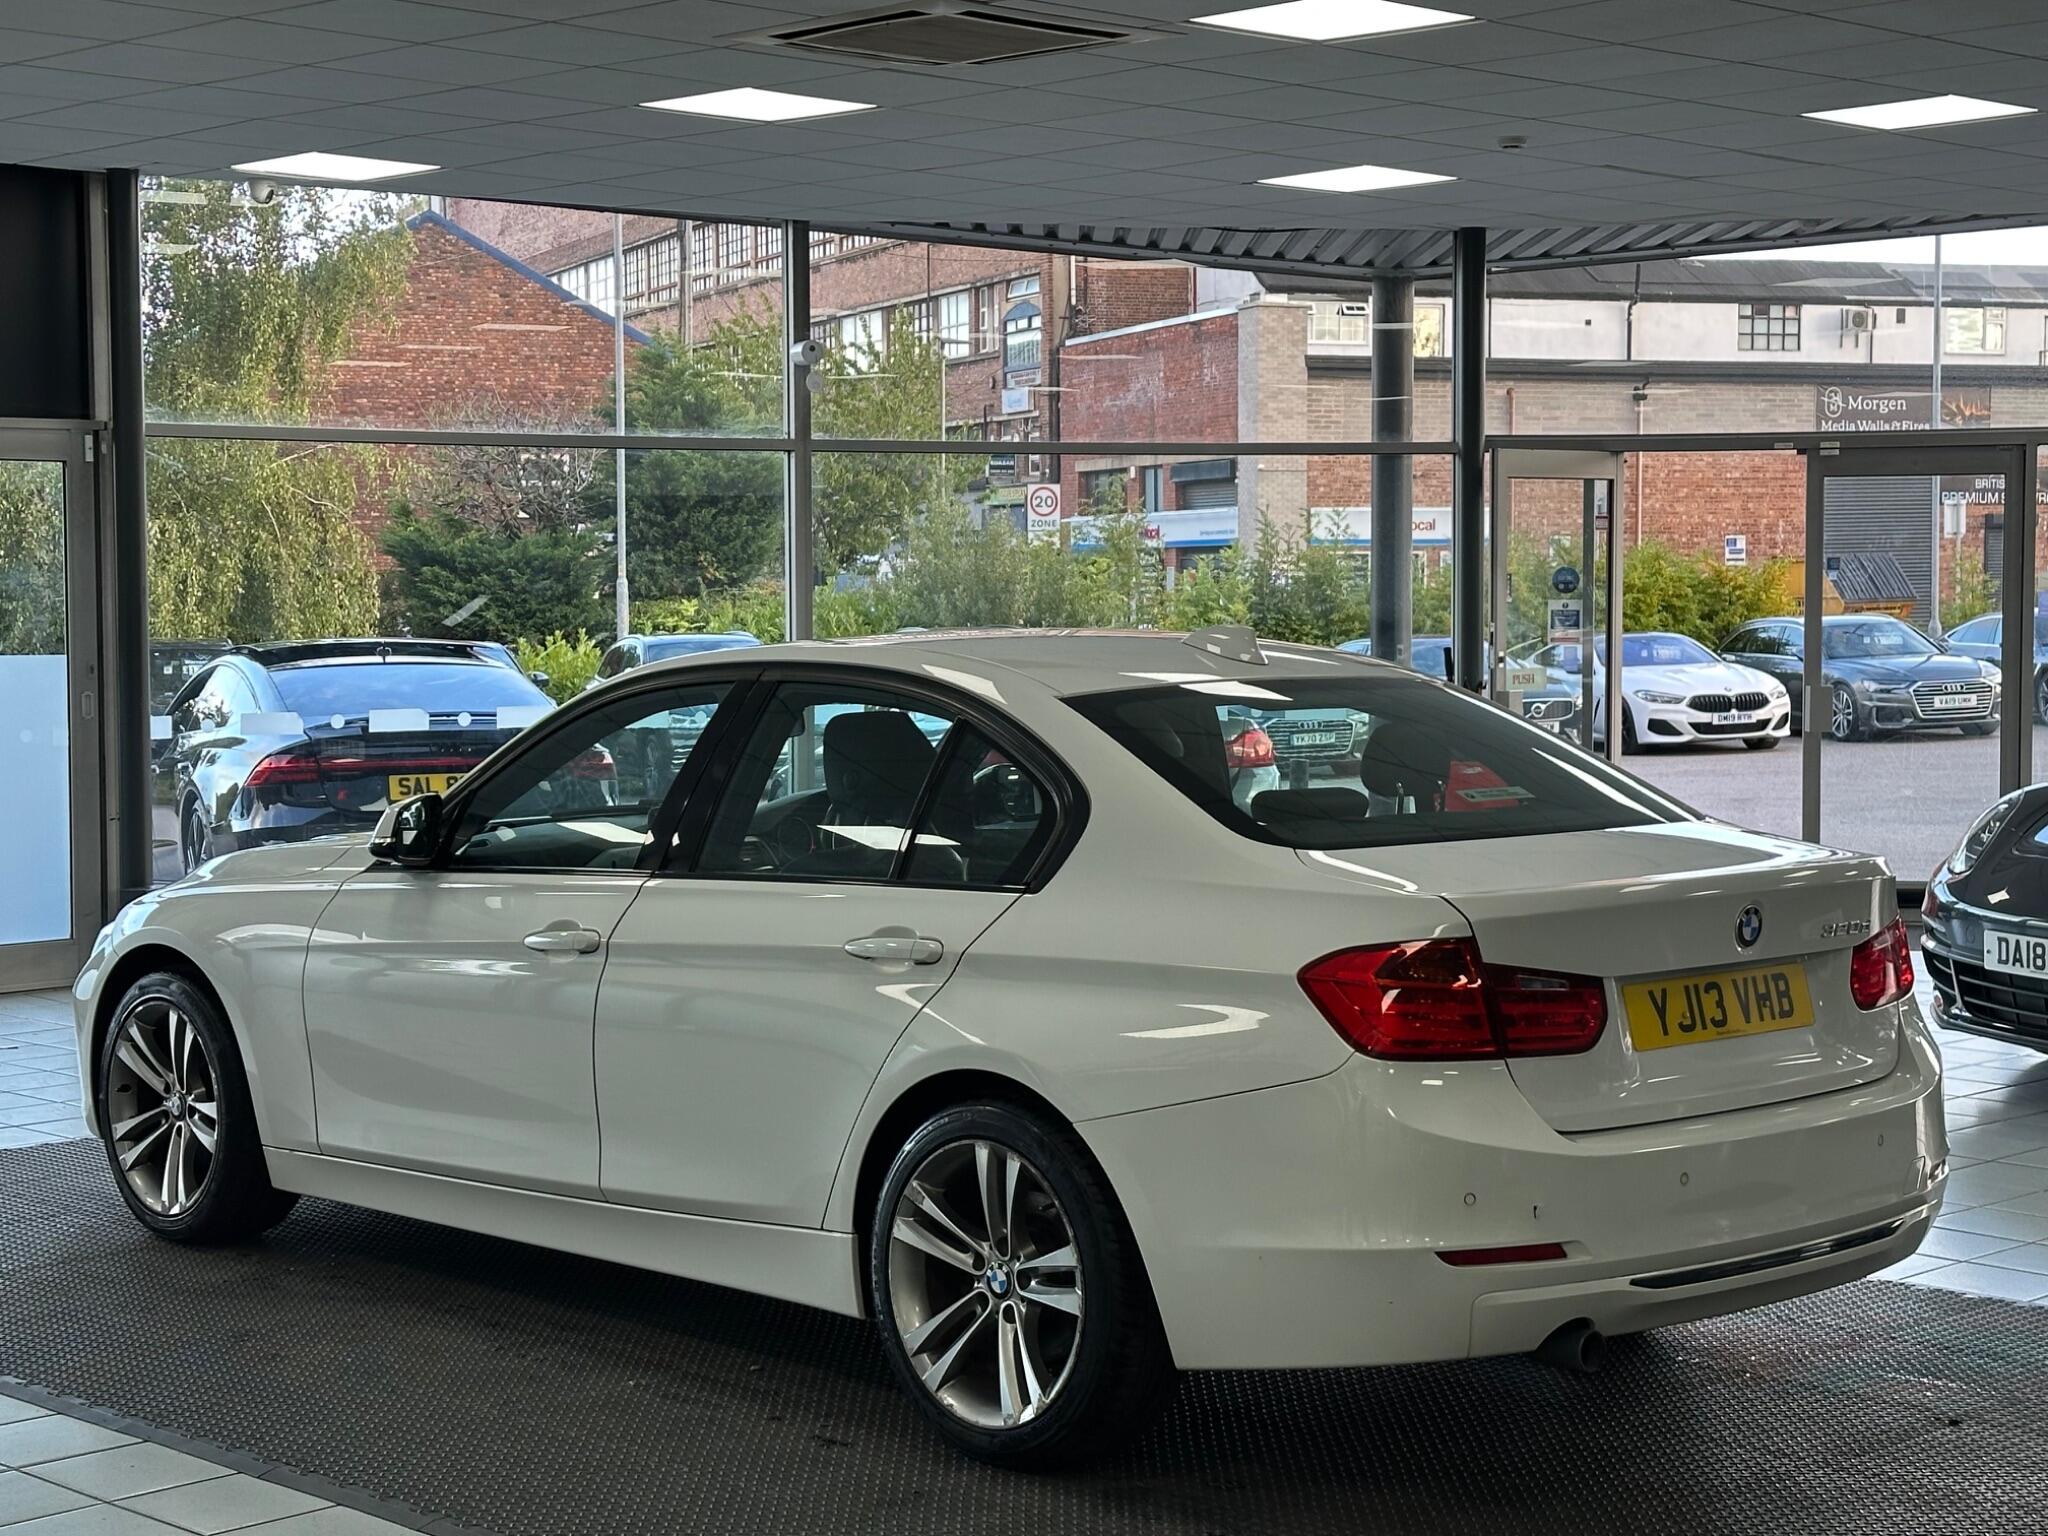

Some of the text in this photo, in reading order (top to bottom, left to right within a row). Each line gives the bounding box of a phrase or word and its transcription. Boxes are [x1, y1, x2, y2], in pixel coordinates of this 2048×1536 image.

[1847, 395, 1907, 414] Morgen
[1821, 420, 1856, 432] Media
[1857, 420, 1890, 432] Walls
[1902, 420, 1930, 431] Fires
[1975, 478, 2005, 489] BRITIS
[1034, 495, 1054, 508] 20
[1941, 491, 1999, 504] PREMIUM
[1031, 520, 1057, 528] ZONE
[1411, 518, 1436, 531] ocal
[1512, 673, 1535, 685] PUSH
[398, 776, 439, 796] SAL
[1996, 935, 2047, 971] DA18
[1647, 972, 1795, 1037] YJ13 VHB
